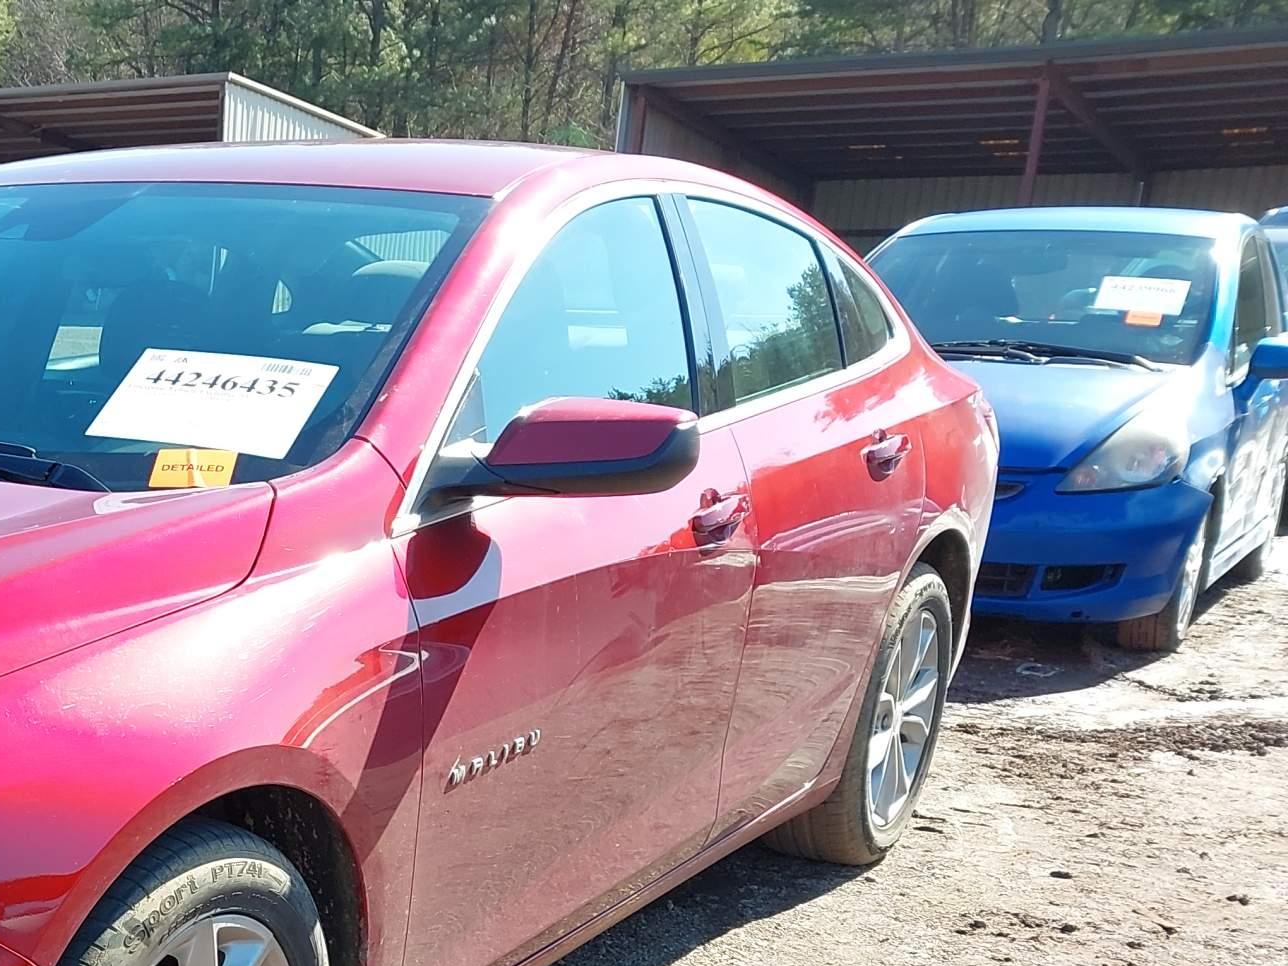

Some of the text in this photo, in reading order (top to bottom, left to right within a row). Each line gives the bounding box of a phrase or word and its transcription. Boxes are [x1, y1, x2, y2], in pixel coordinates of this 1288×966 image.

[146, 369, 301, 398] 44246435
[161, 463, 225, 473] DETAILED
[447, 729, 541, 787] MALIBU
[123, 874, 200, 954] Sport
